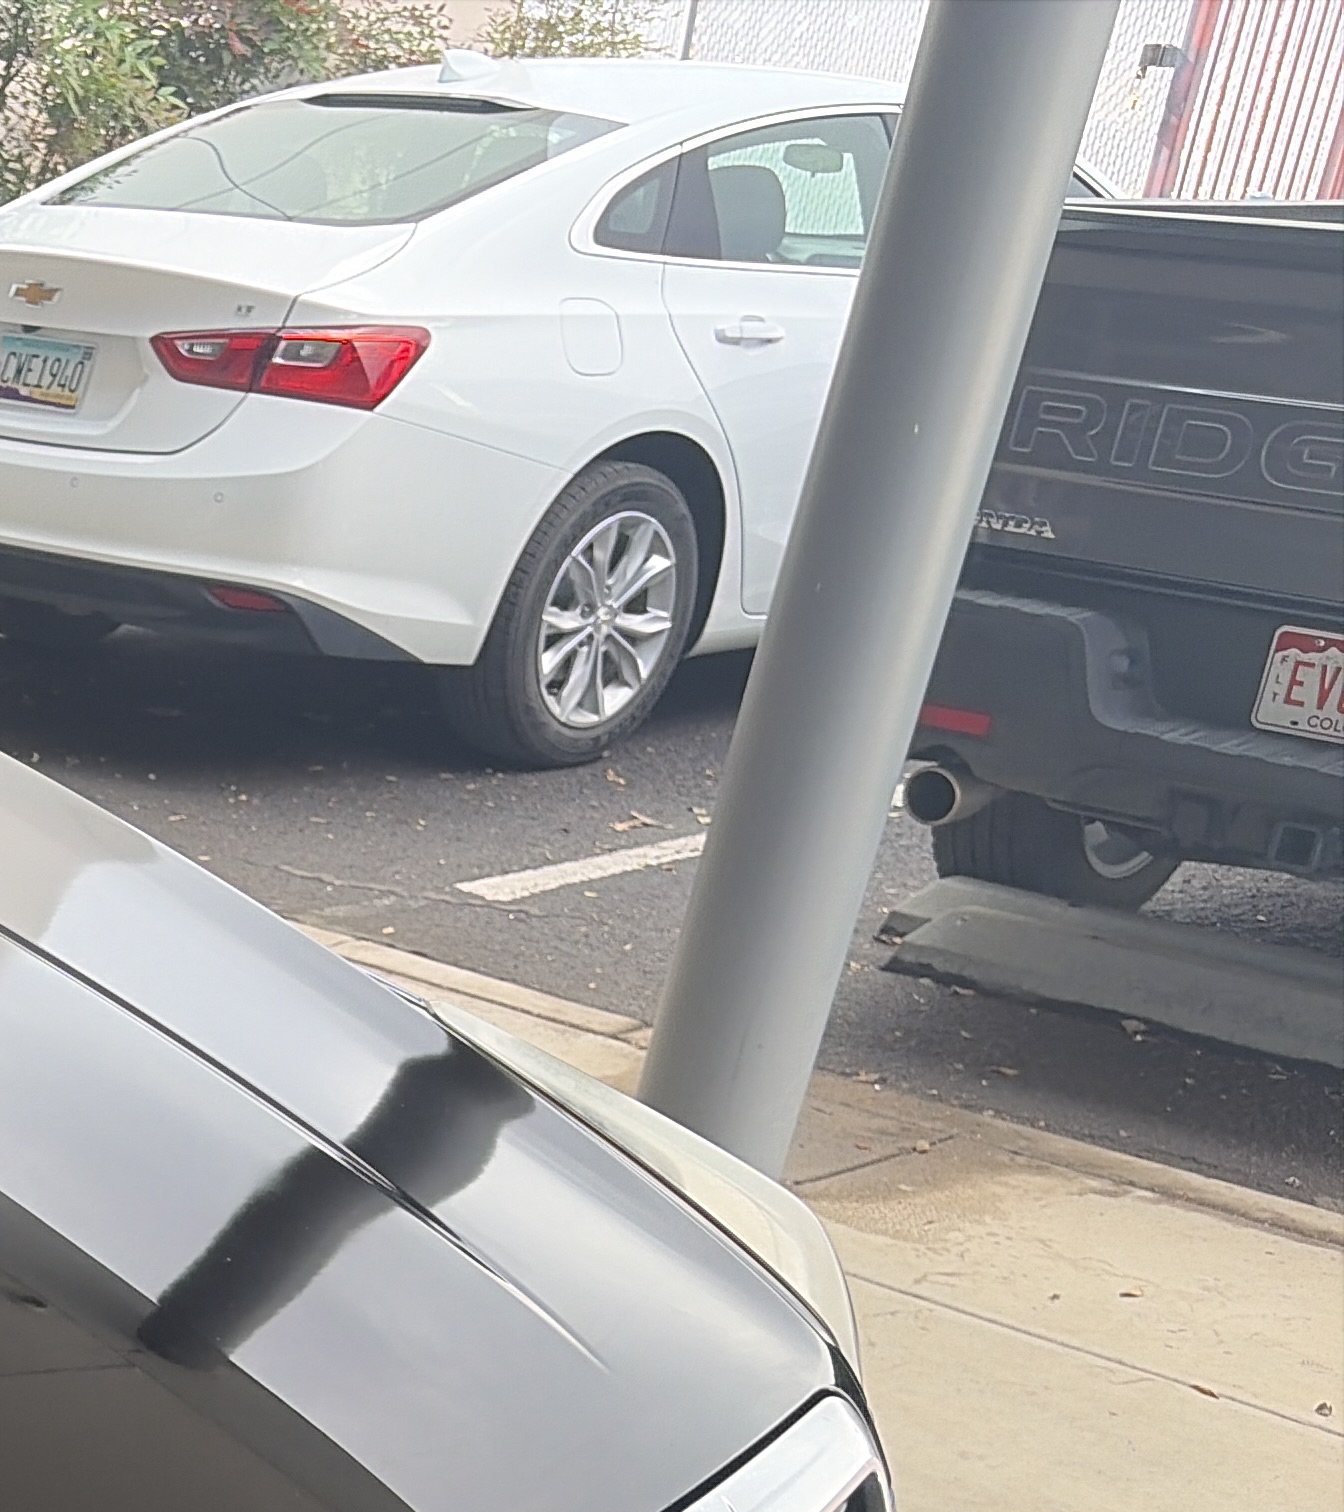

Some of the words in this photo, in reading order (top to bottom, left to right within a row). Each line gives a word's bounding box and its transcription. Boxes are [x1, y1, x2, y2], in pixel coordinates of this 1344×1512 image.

[1008, 386, 1344, 495] RIDG
[974, 509, 1056, 539] NDA
[1307, 714, 1344, 733] COL
